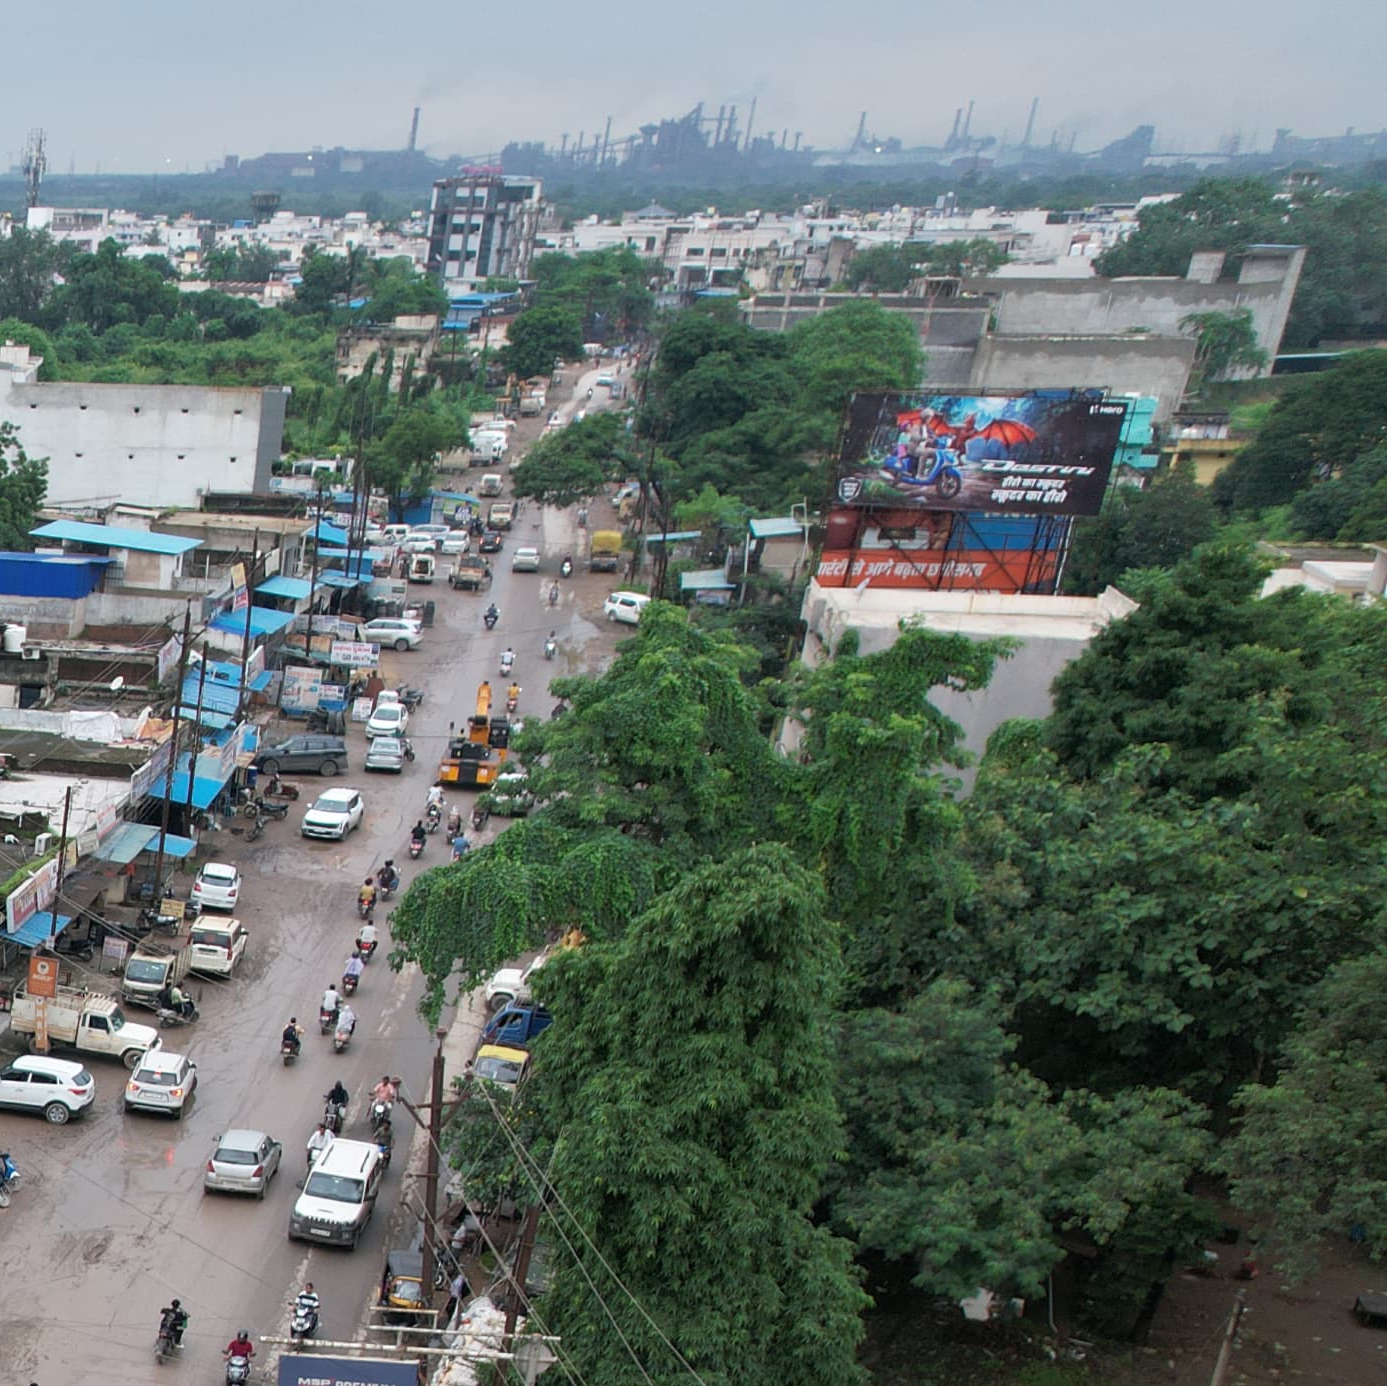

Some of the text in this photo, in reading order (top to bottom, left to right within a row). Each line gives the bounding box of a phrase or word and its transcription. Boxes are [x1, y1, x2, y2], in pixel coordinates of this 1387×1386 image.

[1022, 478, 1037, 488] का
[1025, 489, 1044, 502] का
[297, 1377, 331, 1386] MSP
